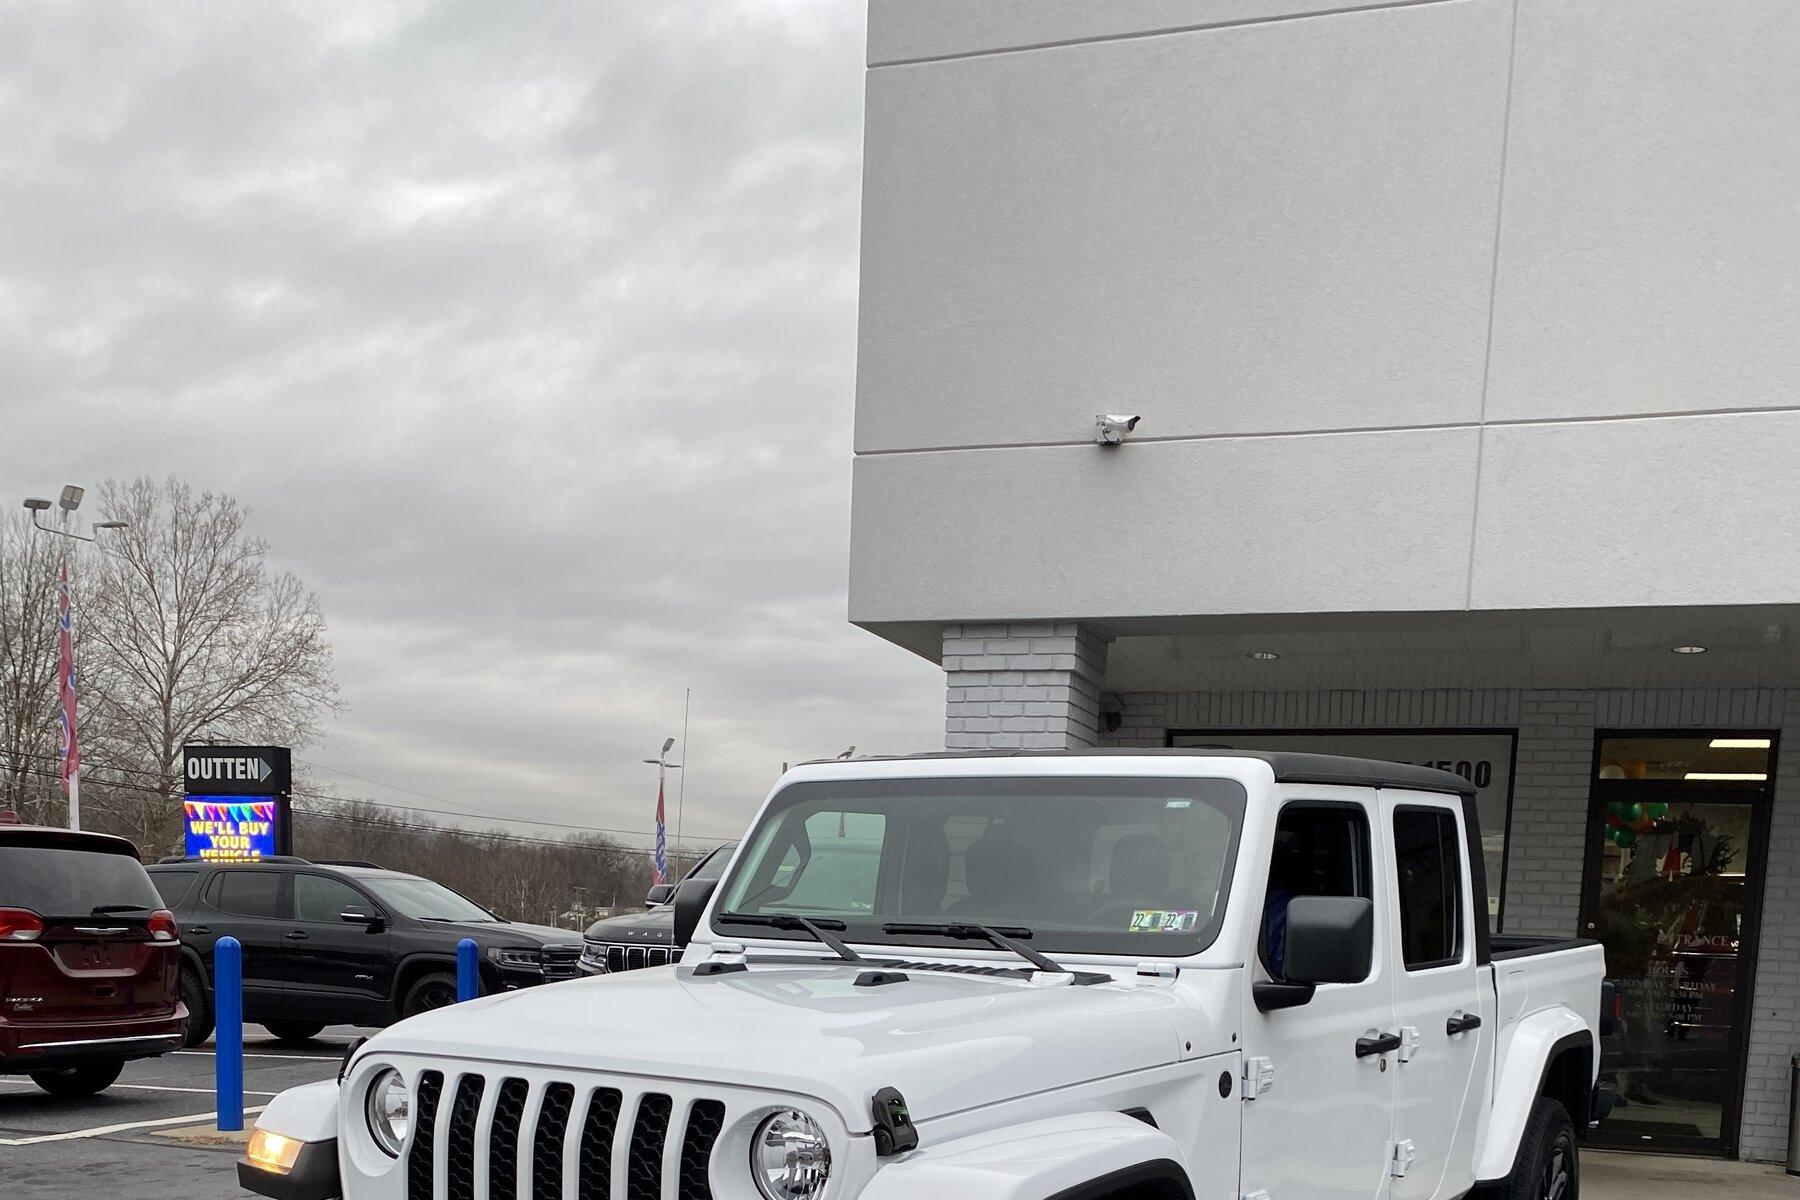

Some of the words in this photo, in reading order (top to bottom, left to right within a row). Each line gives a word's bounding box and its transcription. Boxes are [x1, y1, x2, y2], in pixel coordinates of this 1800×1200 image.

[187, 757, 259, 780] OUTTEN
[1420, 760, 1492, 788] 00
[190, 821, 235, 835] WE'LL
[239, 822, 269, 835] BUY
[210, 836, 250, 849] YOUR
[1132, 913, 1145, 928] 22
[1164, 913, 1177, 928] 22
[1636, 1002, 1695, 1013] SATURDAY
